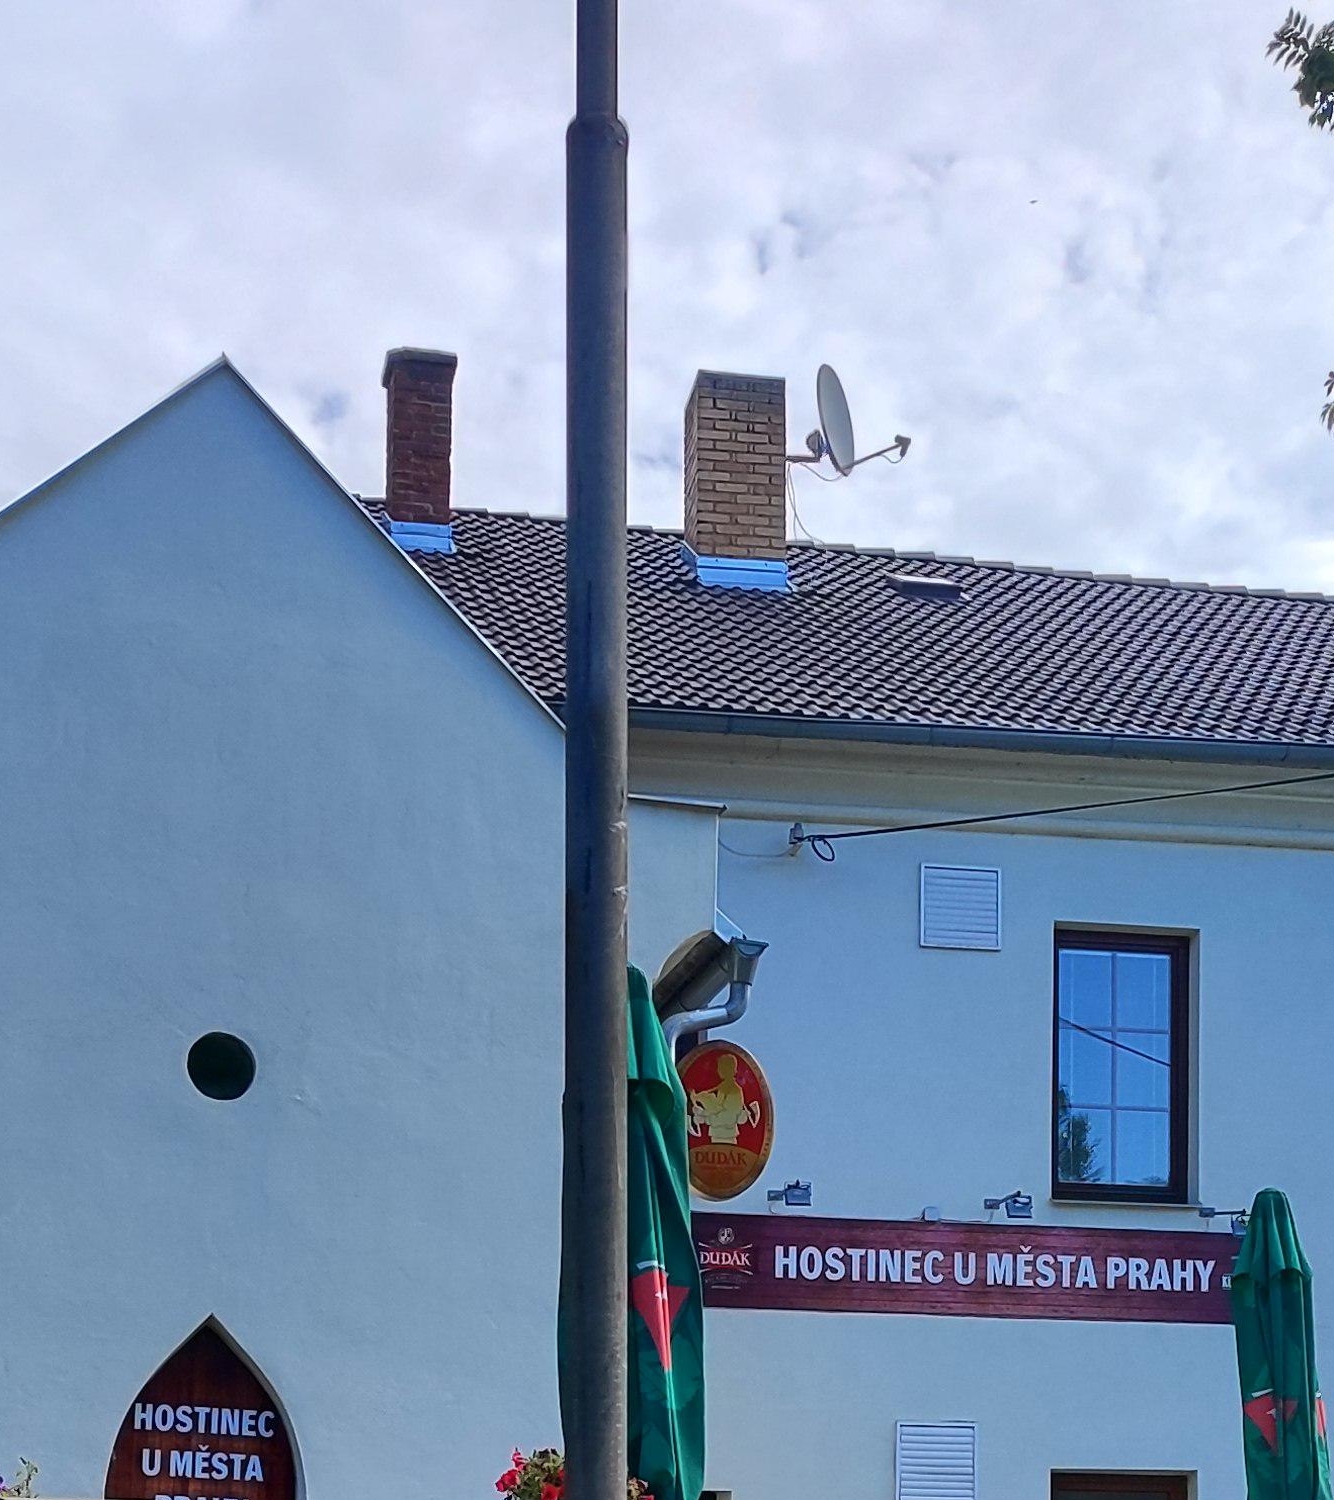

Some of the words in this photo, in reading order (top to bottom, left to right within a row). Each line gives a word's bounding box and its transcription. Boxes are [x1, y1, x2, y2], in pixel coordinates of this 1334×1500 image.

[774, 1245, 944, 1284] HOSTINEC
[953, 1251, 976, 1286] U
[986, 1244, 1098, 1289] MĚSTA
[1105, 1256, 1216, 1292] PRAHY
[133, 1402, 275, 1438] HOSTINEC
[142, 1448, 161, 1476] U
[169, 1444, 264, 1482] MĚSTA
